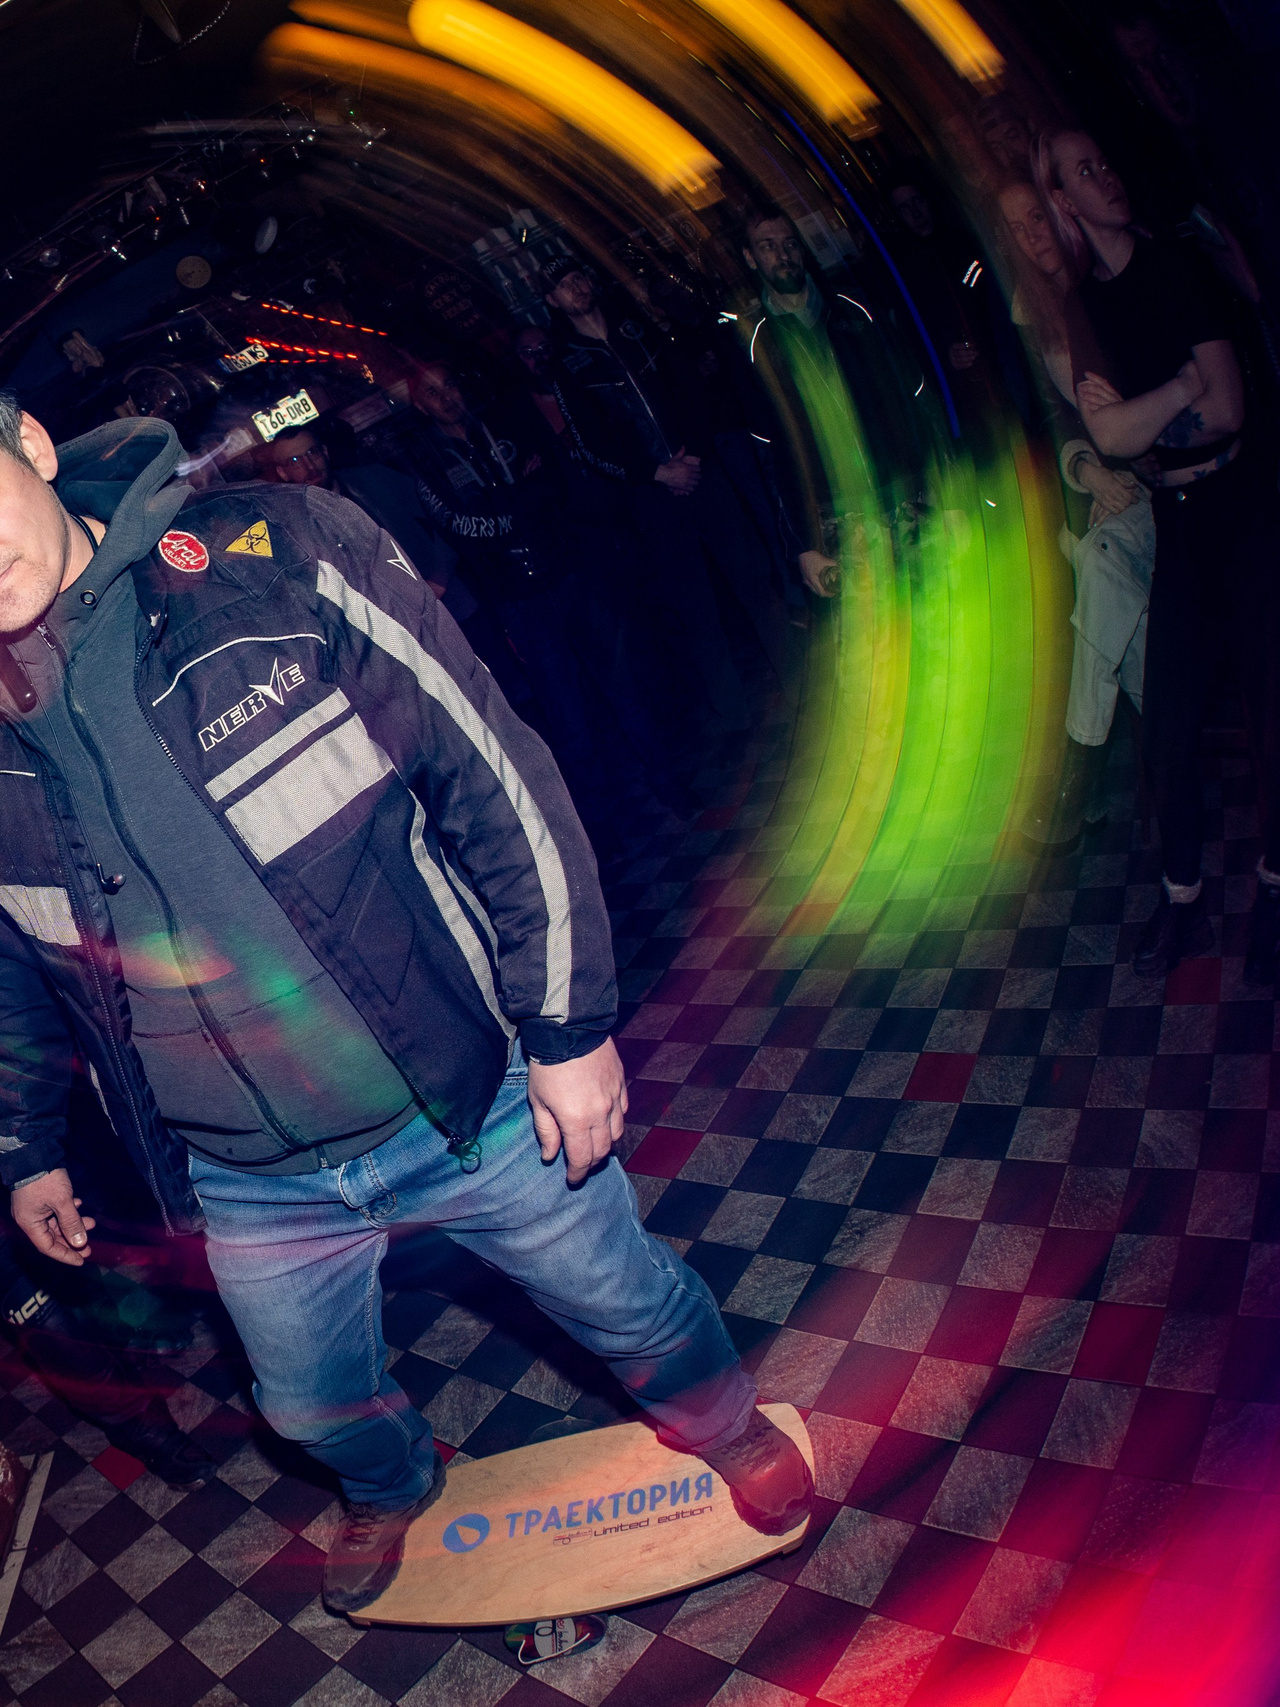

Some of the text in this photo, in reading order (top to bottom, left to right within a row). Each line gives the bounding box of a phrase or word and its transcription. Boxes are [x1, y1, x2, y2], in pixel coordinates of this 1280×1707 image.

[162, 537, 206, 566] Arai
[197, 657, 306, 752] NERVE
[505, 1472, 714, 1538] ТРАЕКТОРИЯ
[657, 1505, 713, 1525] edition
